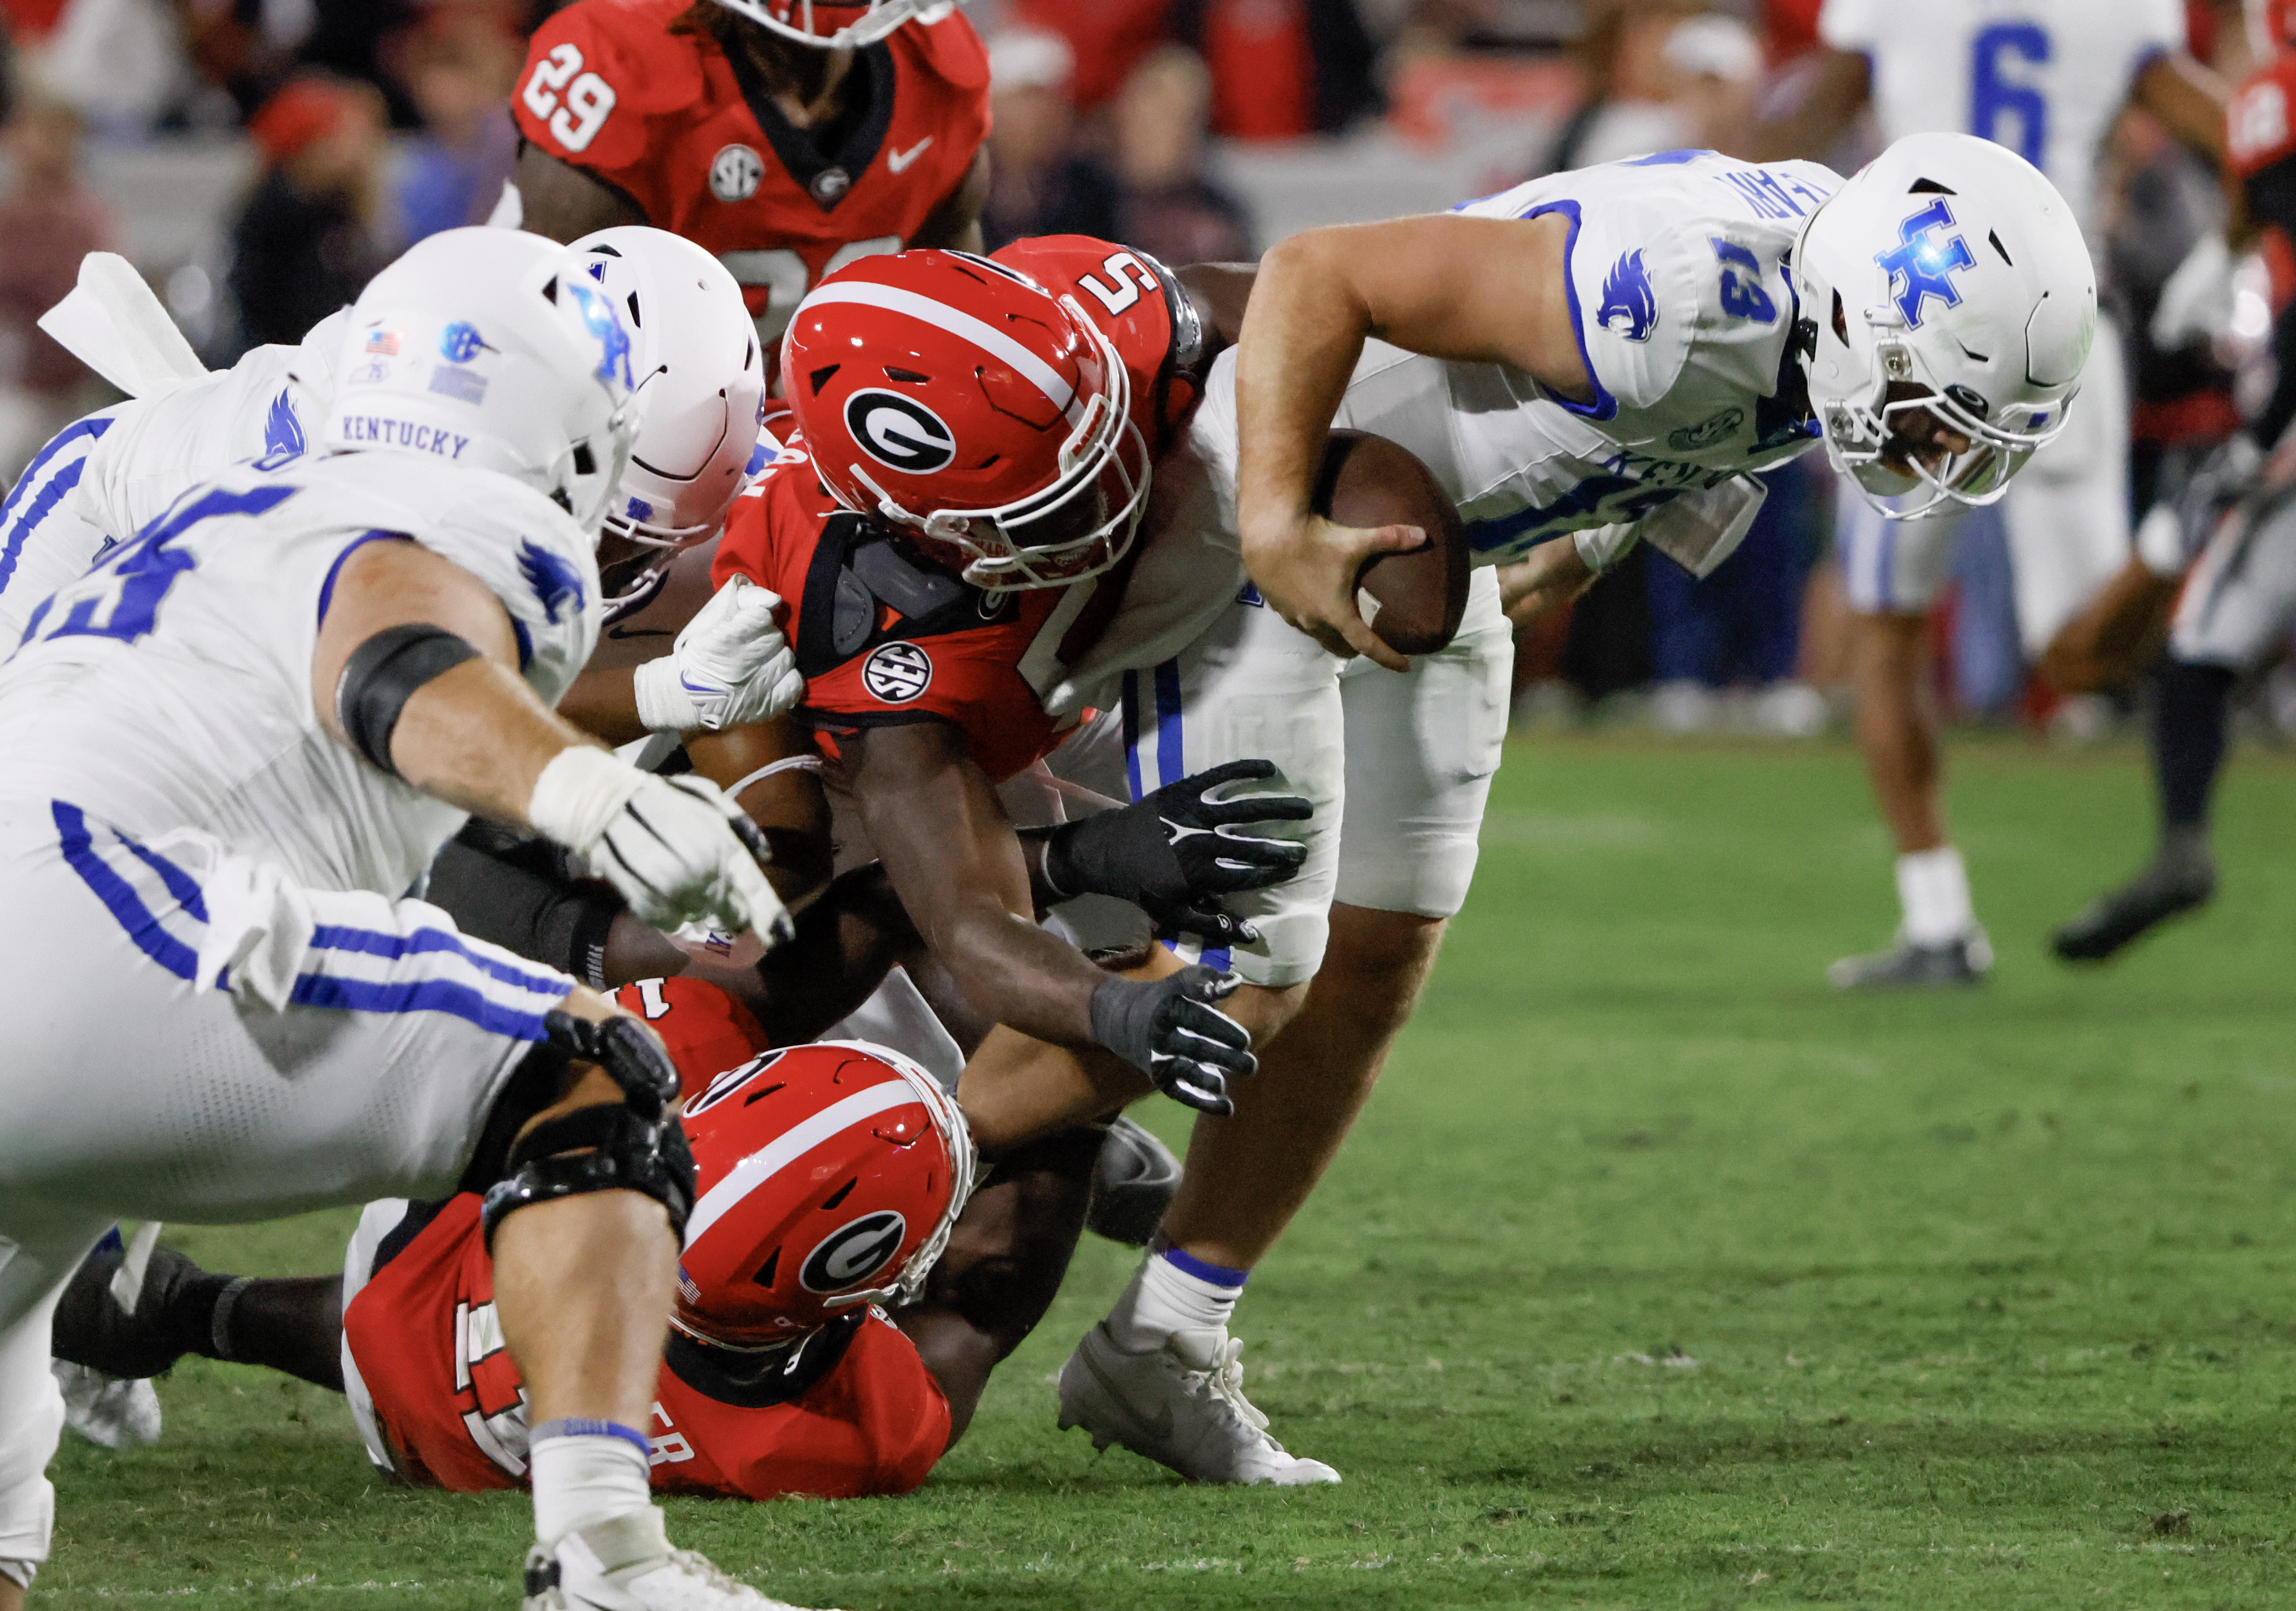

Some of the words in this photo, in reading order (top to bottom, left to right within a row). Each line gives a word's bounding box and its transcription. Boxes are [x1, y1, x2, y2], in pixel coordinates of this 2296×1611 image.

[522, 43, 616, 152] 29
[1971, 20, 2050, 174] 6
[1076, 251, 1160, 317] 5
[343, 416, 469, 459] KENTUCKY
[846, 390, 954, 473] G
[866, 644, 930, 700] SEC
[802, 1212, 905, 1292] G
